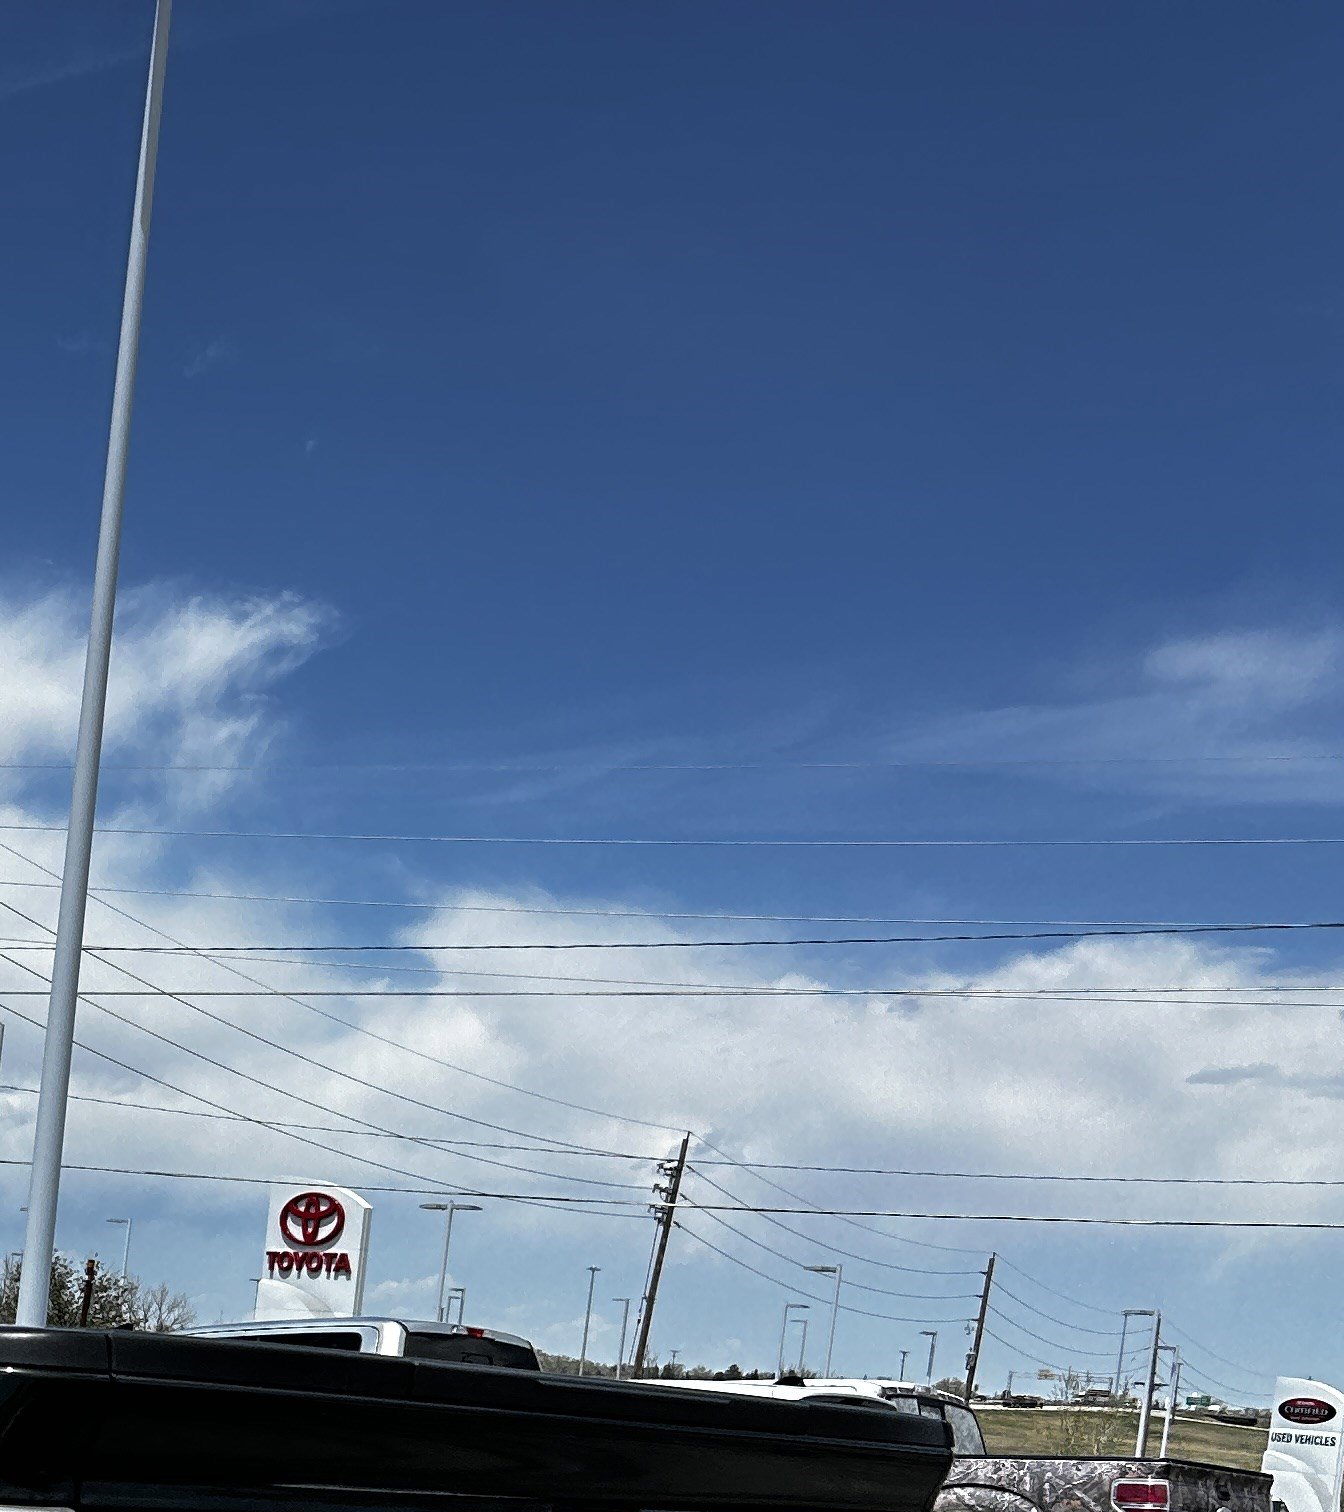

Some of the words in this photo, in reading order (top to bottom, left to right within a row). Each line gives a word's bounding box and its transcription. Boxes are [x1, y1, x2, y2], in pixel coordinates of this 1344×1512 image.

[265, 1250, 352, 1275] TOYOTA
[1271, 1431, 1293, 1444] USED
[1294, 1433, 1338, 1448] VEHICLES
